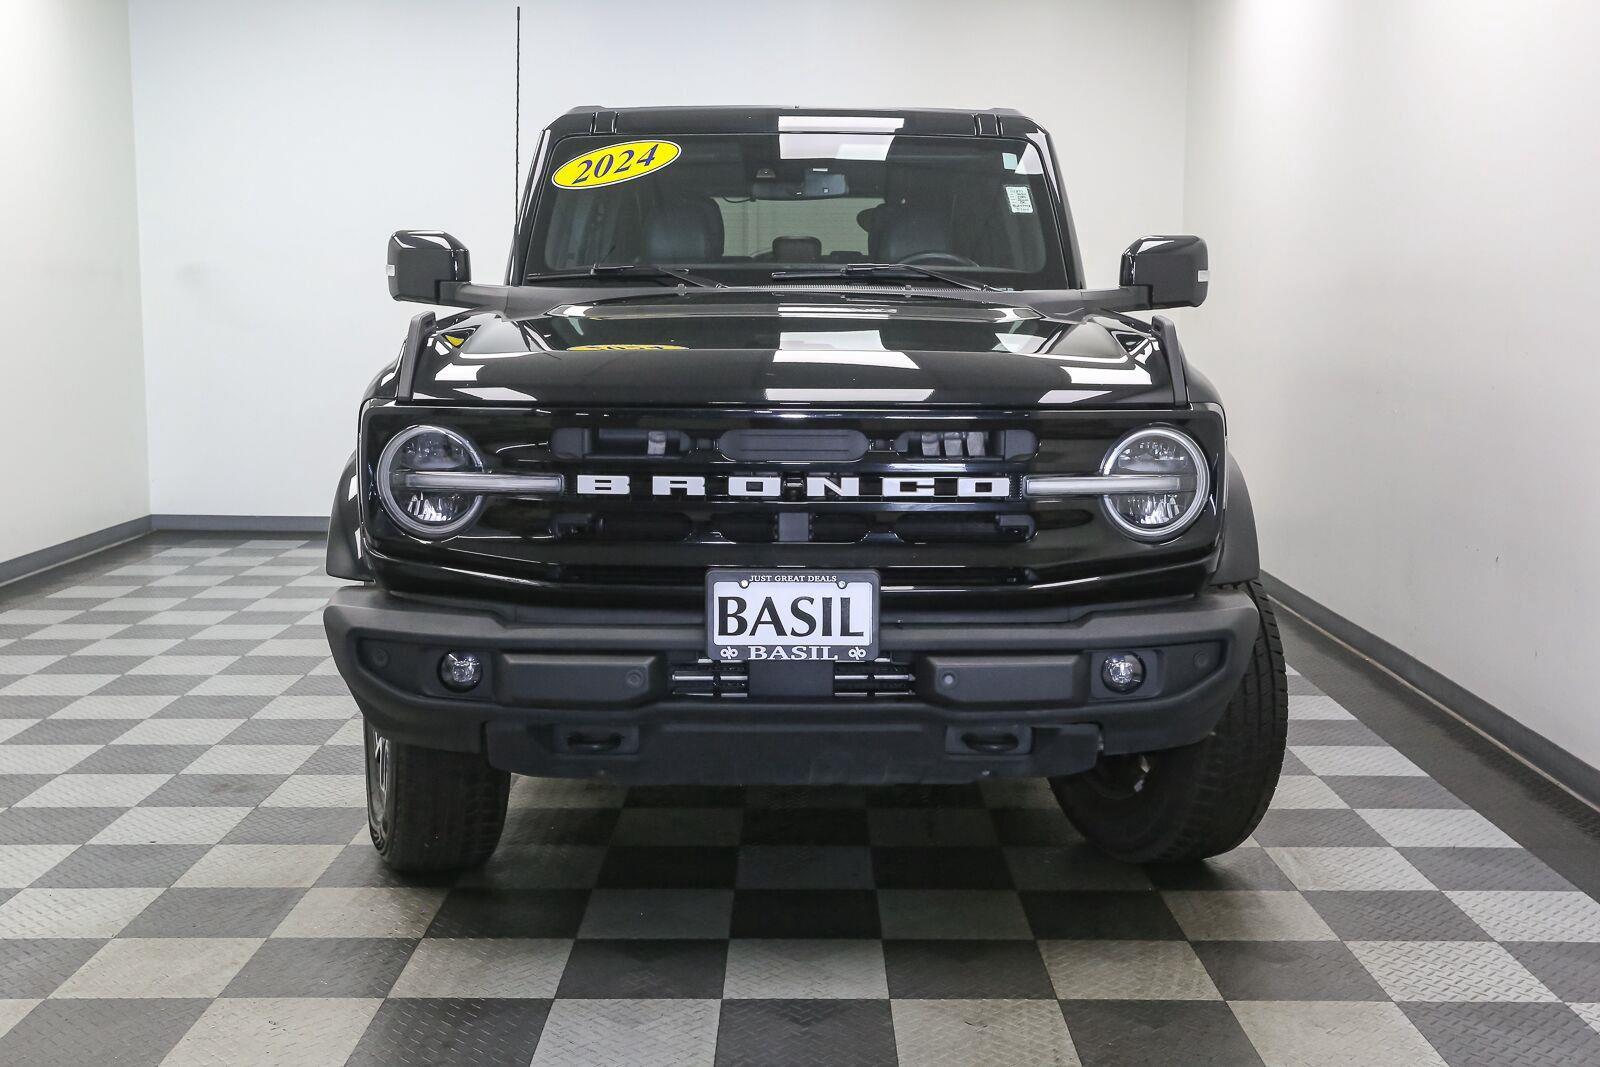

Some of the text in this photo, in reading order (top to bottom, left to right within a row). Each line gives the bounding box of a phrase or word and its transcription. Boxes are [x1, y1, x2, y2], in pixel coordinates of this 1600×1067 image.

[572, 143, 659, 185] 2024
[576, 474, 1010, 497] BRONCO
[718, 596, 864, 637] BASIL
[747, 645, 838, 660] BASIL
